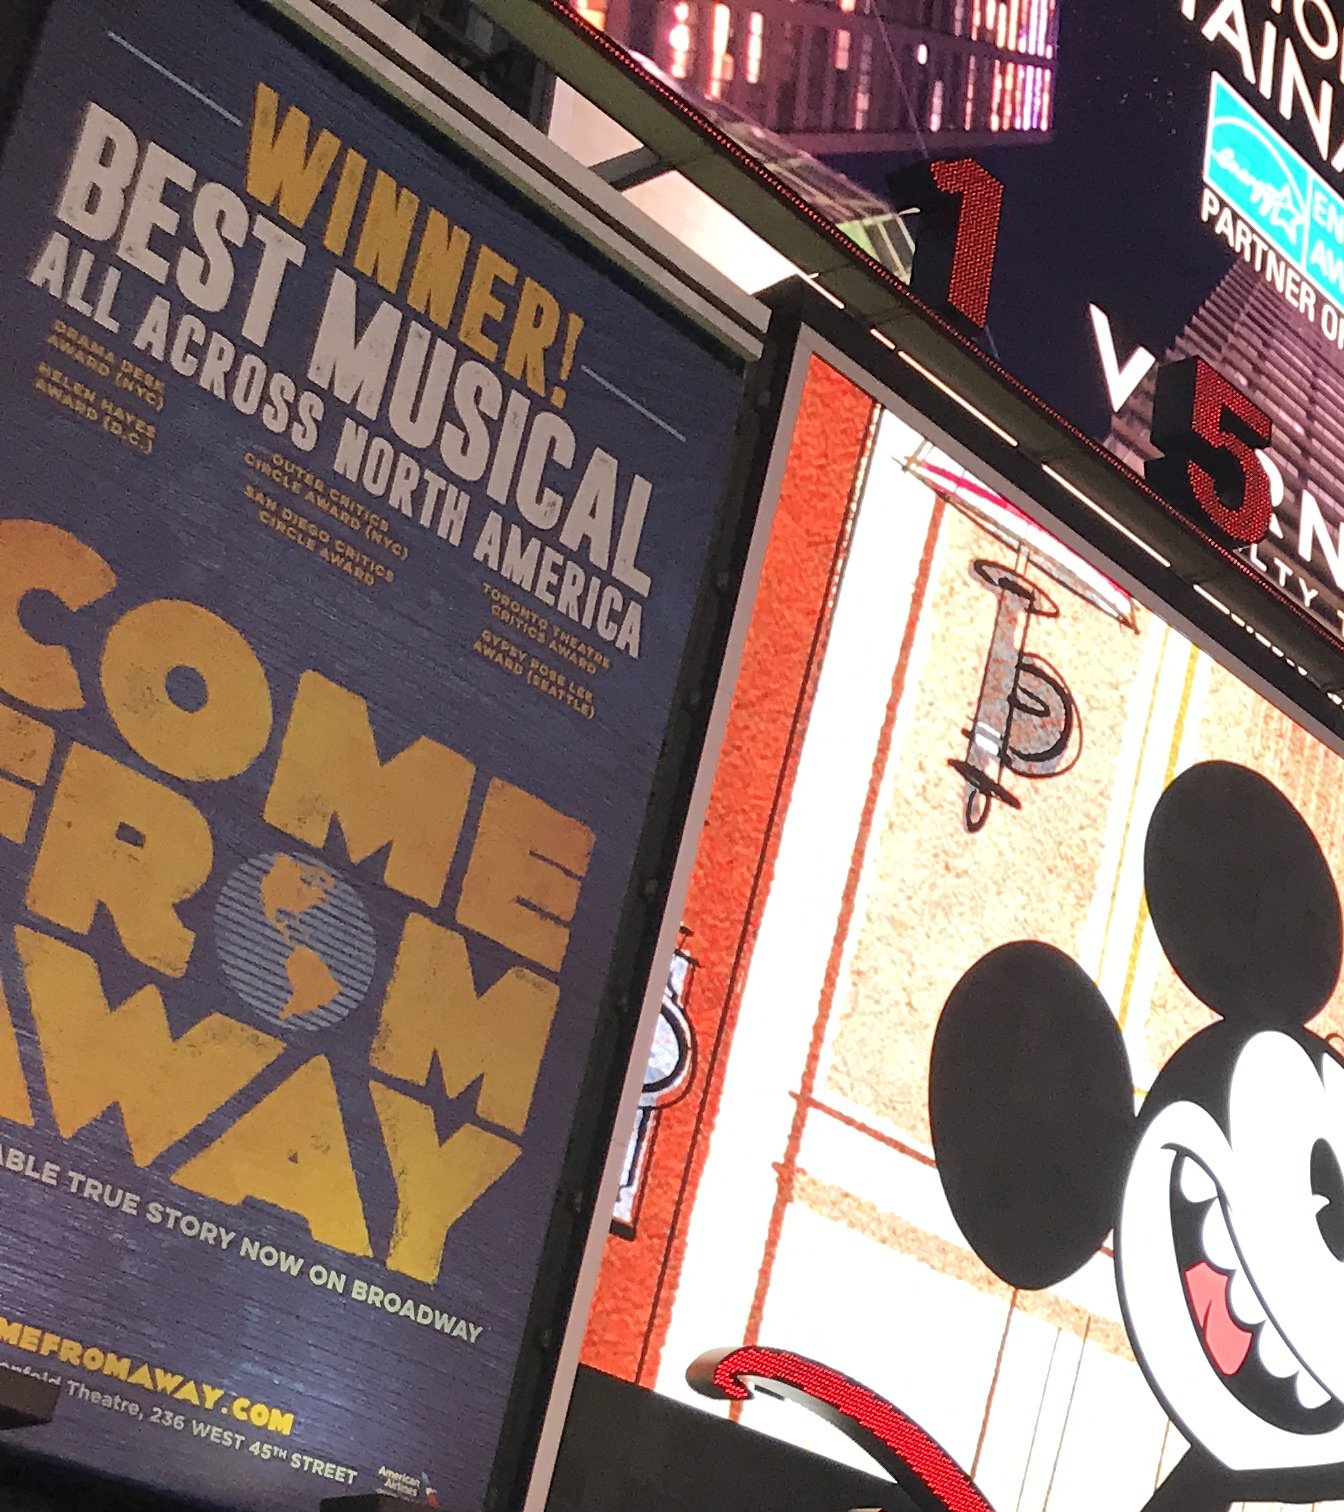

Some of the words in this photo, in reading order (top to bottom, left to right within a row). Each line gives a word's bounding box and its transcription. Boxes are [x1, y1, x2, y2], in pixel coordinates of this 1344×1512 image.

[245, 81, 585, 408] WINNER!
[1202, 189, 1316, 328] PARTNER
[37, 361, 97, 402] HELEN
[46, 332, 111, 377] AWARD
[114, 368, 165, 412] (NYC)
[53, 319, 115, 363] DRAMA
[119, 358, 166, 394] DESK
[55, 101, 306, 350] BEST
[307, 268, 652, 598] MUSICAL
[34, 378, 98, 421] AWARD
[29, 231, 120, 333] ALL
[132, 295, 324, 452] ACROSS
[333, 416, 470, 547] NORTH
[473, 514, 643, 659] AMERICA
[243, 451, 302, 496] CIRCLE
[303, 489, 362, 532] AWARD
[364, 518, 409, 561] (NYC)
[271, 453, 325, 492] OUTER
[328, 486, 390, 533] CRITICS
[244, 484, 278, 515] SAN
[282, 506, 331, 544] DIEGO
[333, 538, 395, 583] CRITICS
[258, 509, 316, 552] CIRCLE
[319, 545, 376, 587] AWARD
[483, 582, 549, 630] TORONTO
[473, 639, 523, 675] AWARD
[549, 640, 597, 675] AWARD
[0, 519, 596, 972] COME
[66, 1170, 141, 1217] TRUE
[145, 1202, 236, 1250] STORY
[239, 1237, 304, 1279] NOW
[309, 1264, 348, 1295] ON
[351, 1278, 484, 1345] BROADWAY
[67, 1379, 144, 1421] Theatre,
[150, 1406, 185, 1432] 236
[191, 1420, 246, 1451] WEST
[290, 1453, 358, 1486] STREET
[378, 1465, 421, 1487] American
[383, 1479, 419, 1497] Airlines
